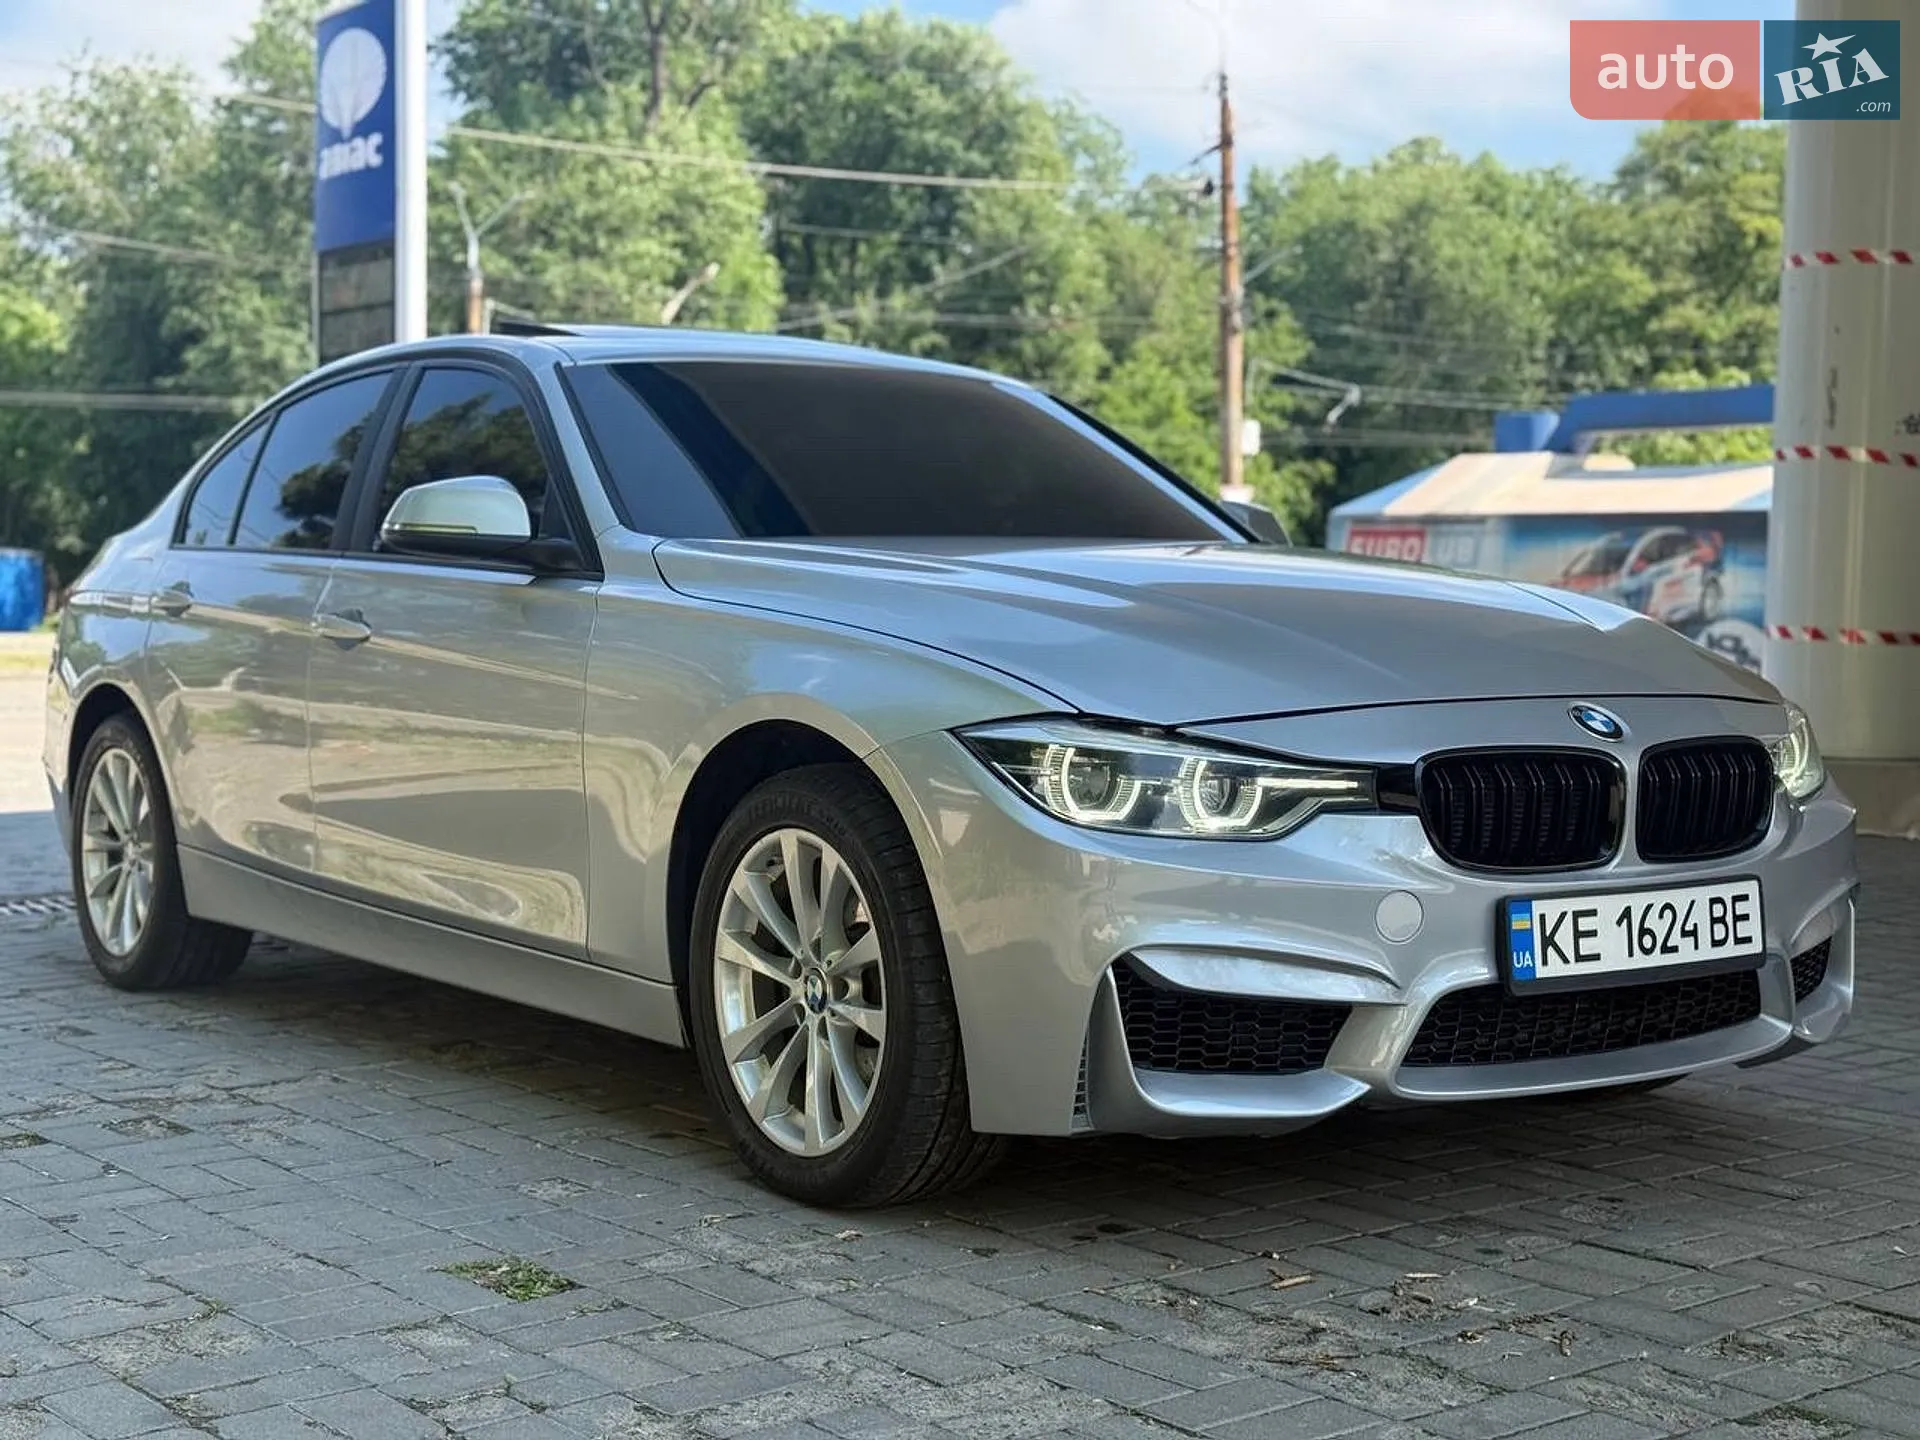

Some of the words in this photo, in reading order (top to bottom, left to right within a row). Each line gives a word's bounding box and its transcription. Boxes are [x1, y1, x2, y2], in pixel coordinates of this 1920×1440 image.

[1538, 908, 1601, 967] KE
[1616, 899, 1700, 958] 1624
[1708, 894, 1753, 948] BE
[1513, 950, 1533, 968] UA
